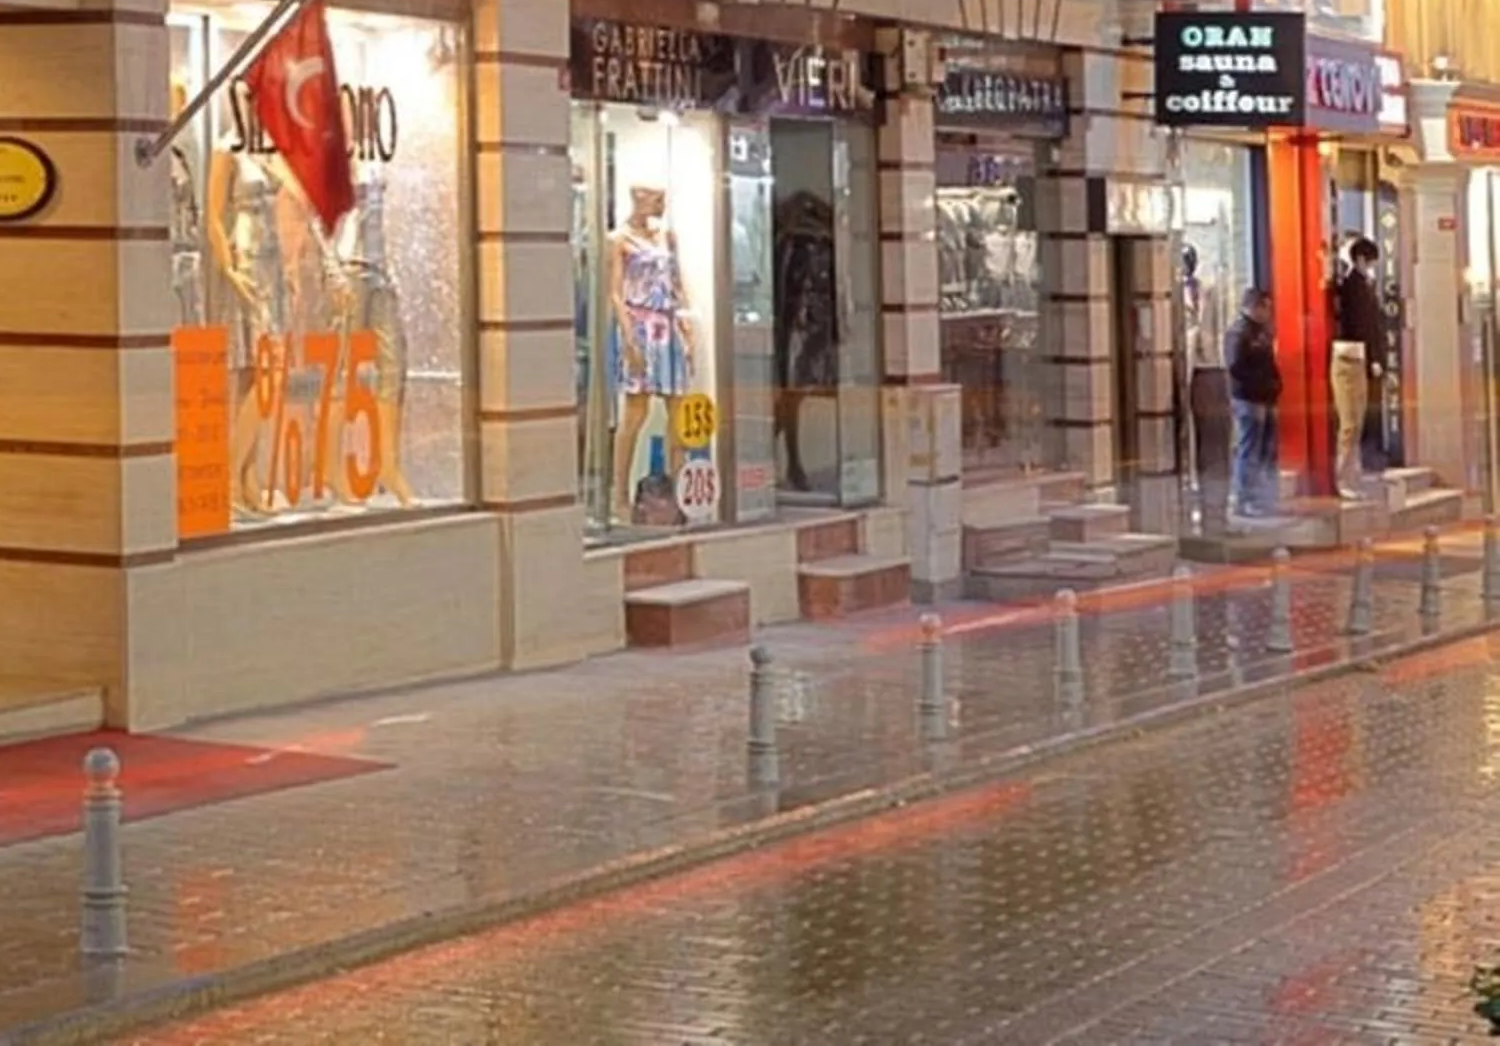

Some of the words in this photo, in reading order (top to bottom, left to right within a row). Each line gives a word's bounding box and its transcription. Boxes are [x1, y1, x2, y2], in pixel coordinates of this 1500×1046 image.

[1181, 26, 1274, 47] ORAN
[1179, 55, 1277, 72] sauna
[1165, 90, 1294, 113] coiffeur
[257, 329, 381, 508] %75
